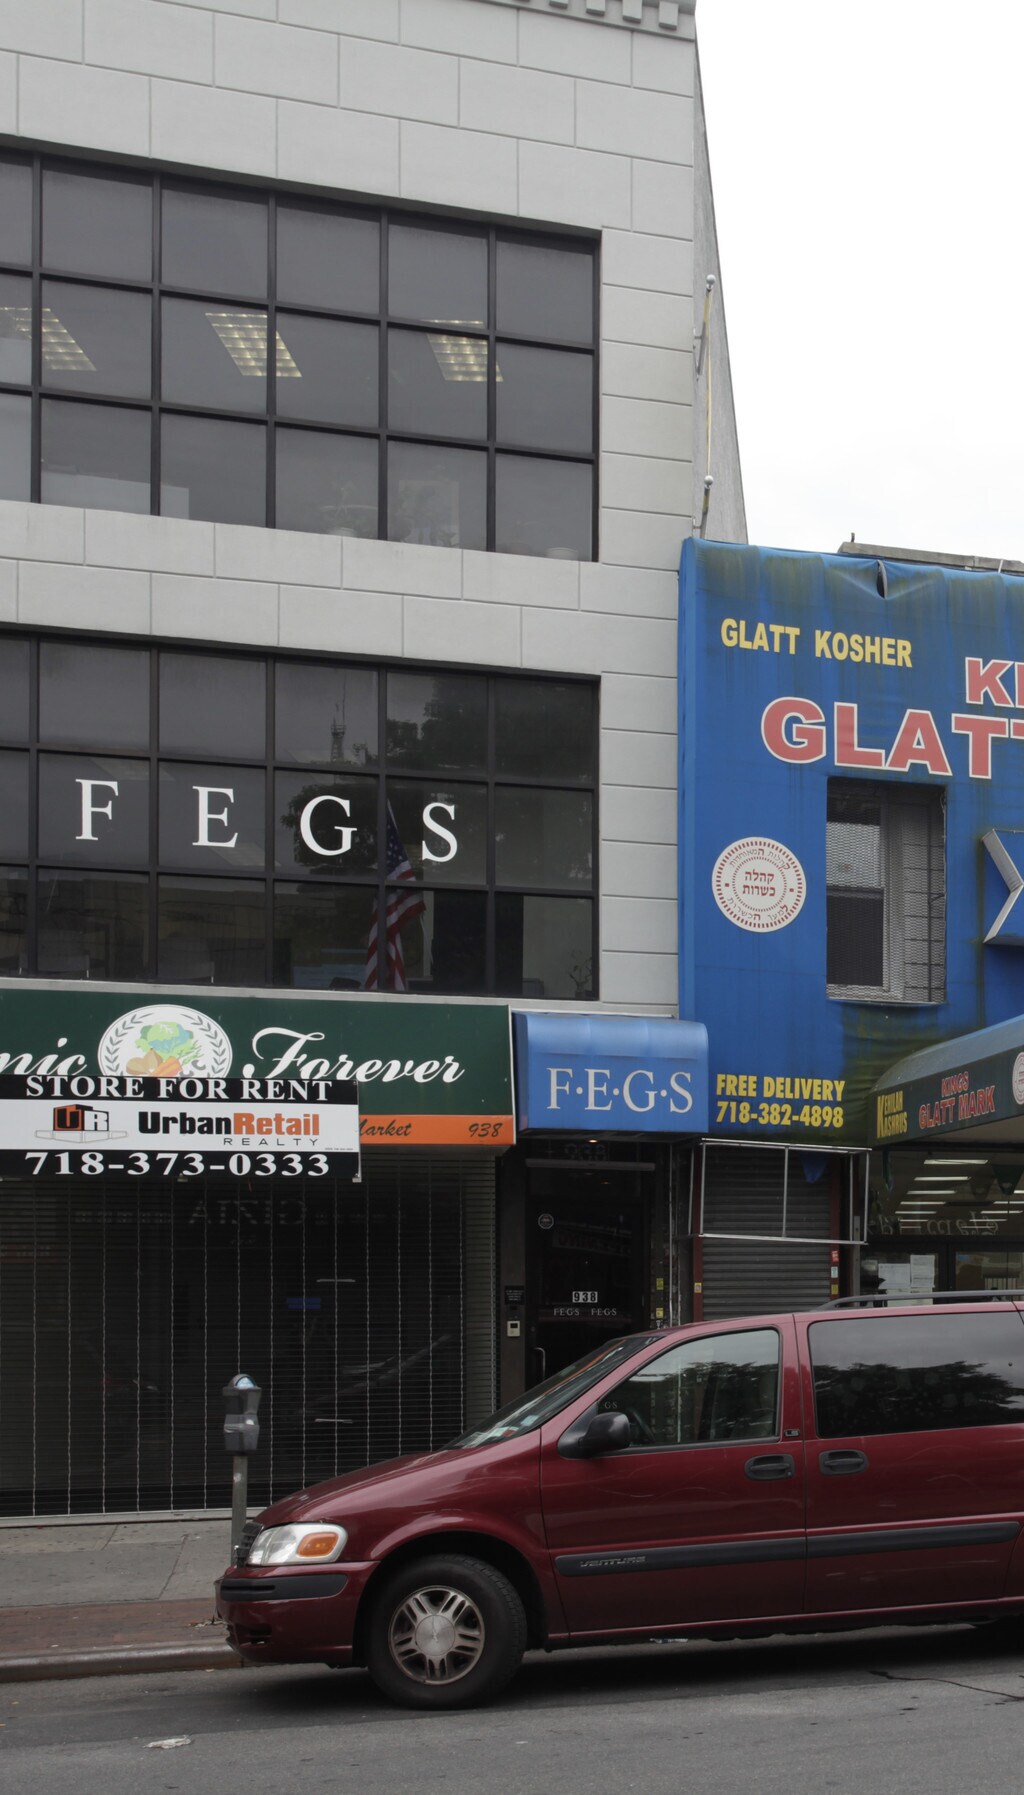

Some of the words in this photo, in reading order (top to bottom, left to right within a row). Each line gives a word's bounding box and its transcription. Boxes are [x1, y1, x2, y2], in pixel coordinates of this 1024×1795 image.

[720, 618, 800, 655] GLATT
[815, 629, 912, 668] KOSHER
[744, 869, 775, 885] קהלה
[742, 885, 776, 897] כשרות
[242, 1027, 466, 1083] Forever
[26, 1075, 145, 1099] STORE
[157, 1077, 230, 1100] FOR
[240, 1079, 333, 1101] RENT
[716, 1073, 757, 1098] FREE
[763, 1077, 846, 1103] DELIVERY
[941, 1071, 969, 1097] KINGS
[716, 1100, 844, 1129] 718-382-4898
[918, 1097, 956, 1130] GLATT
[958, 1085, 996, 1121] MARK
[223, 1137, 320, 1147] REALTY
[468, 1121, 504, 1138] 938
[24, 1151, 330, 1177] 718-373-0333
[573, 1292, 597, 1302] 938
[580, 1555, 647, 1567] VENTURE
